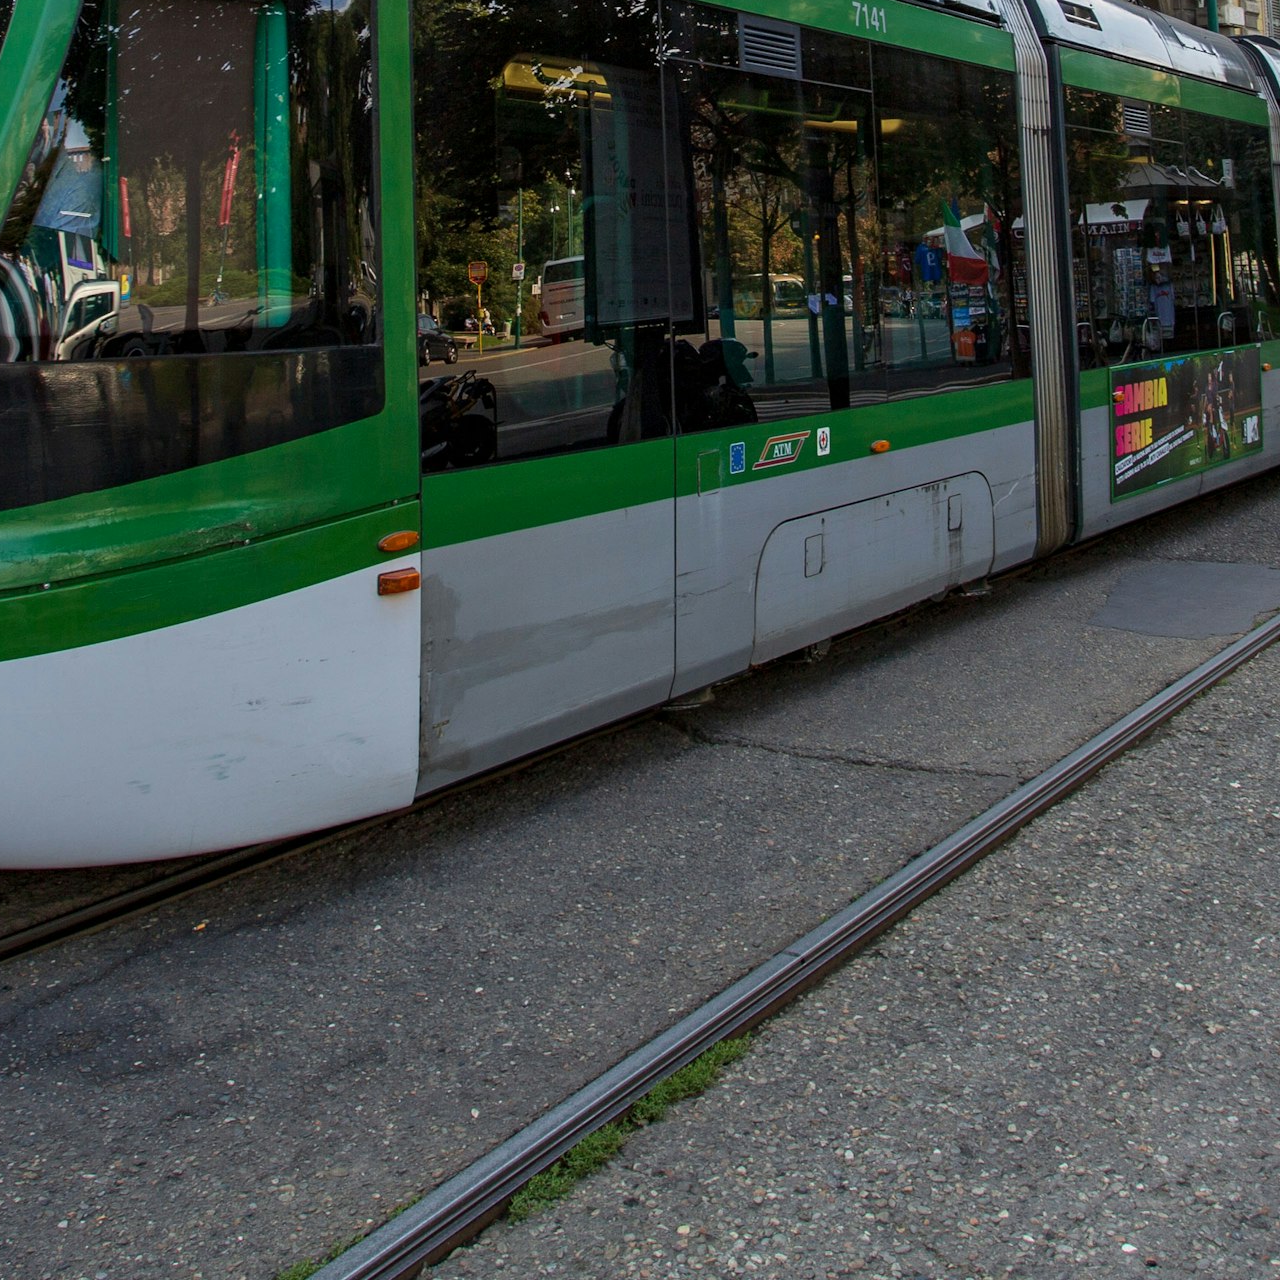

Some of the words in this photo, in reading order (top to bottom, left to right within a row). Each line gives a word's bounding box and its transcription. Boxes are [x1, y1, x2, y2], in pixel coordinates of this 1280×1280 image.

[852, 1, 887, 33] 7141
[773, 442, 792, 458] ATM
[1115, 417, 1152, 457] SERIE
